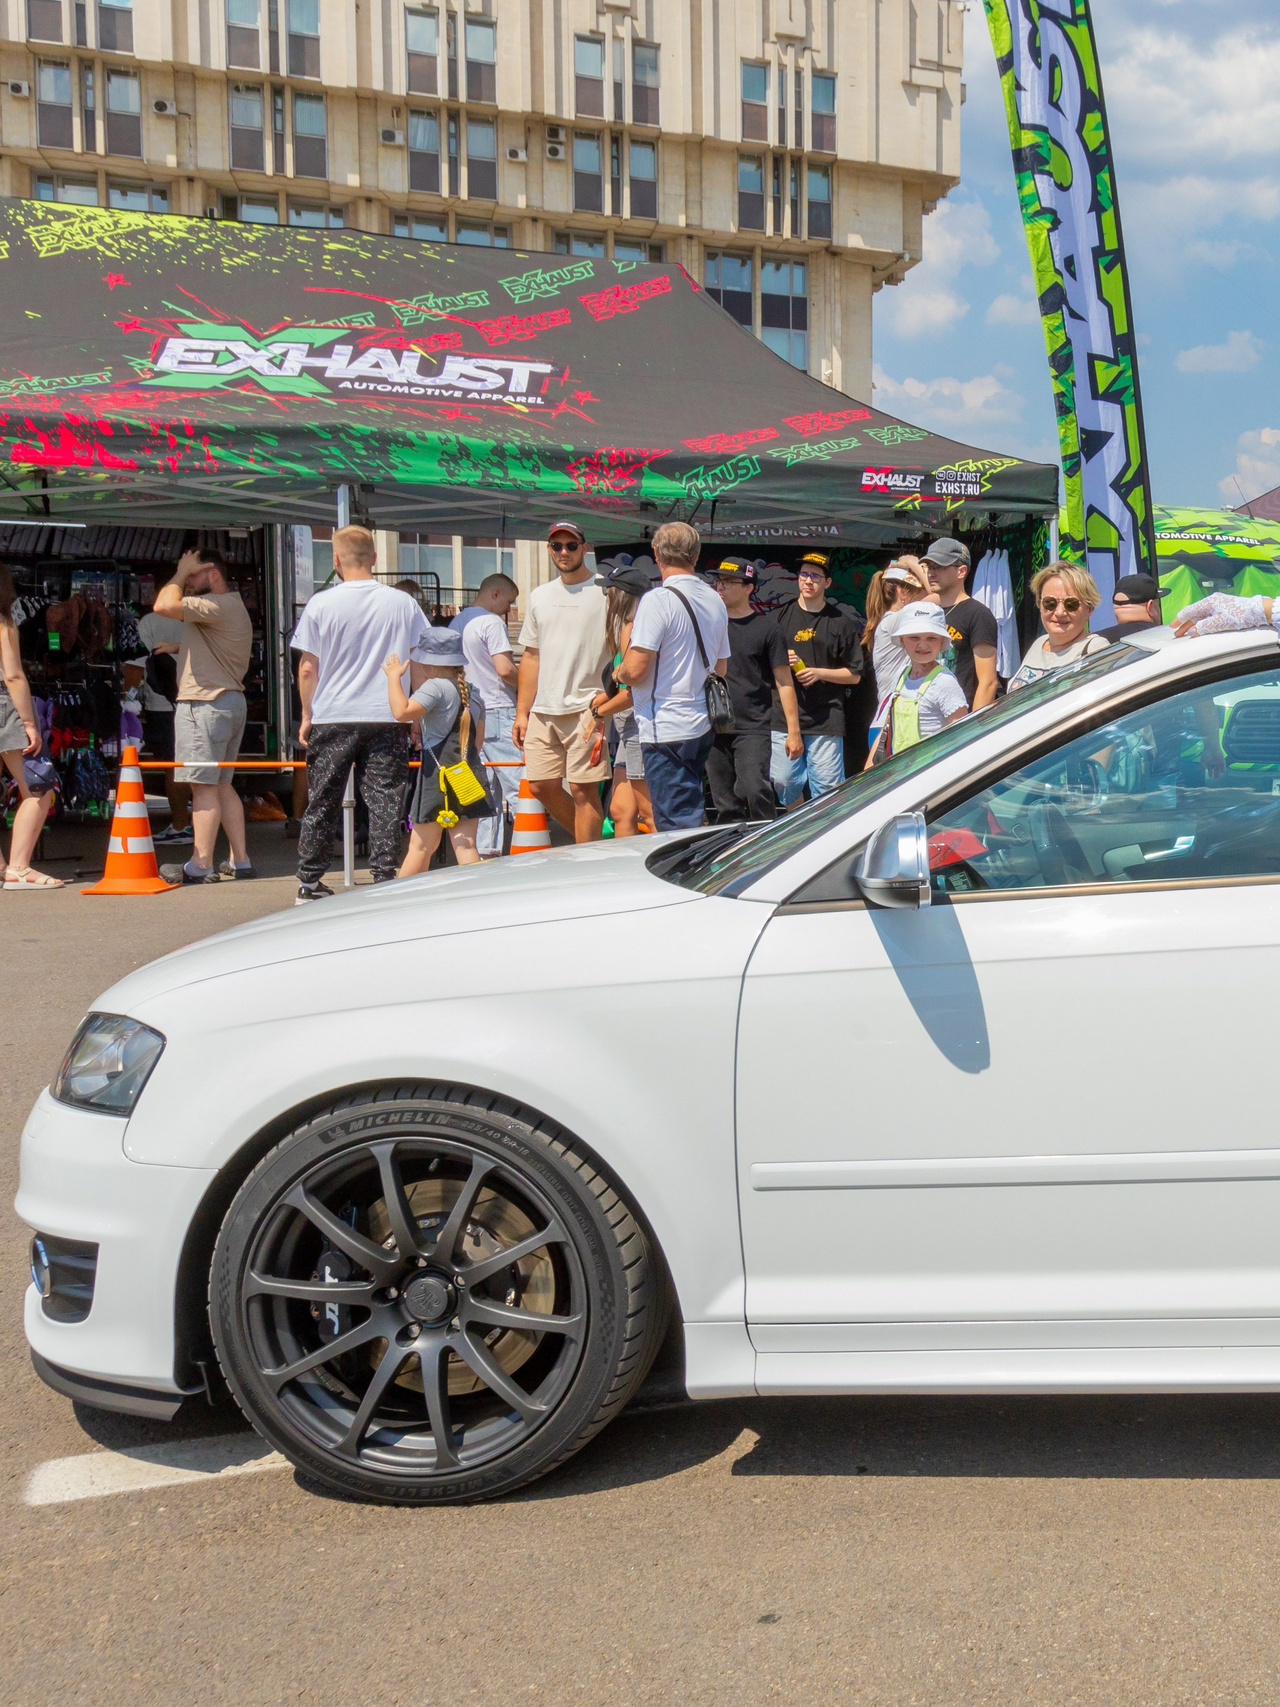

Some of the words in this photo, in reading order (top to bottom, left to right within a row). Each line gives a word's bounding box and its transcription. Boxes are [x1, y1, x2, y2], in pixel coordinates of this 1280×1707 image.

[498, 260, 594, 304] EXHAUST
[386, 290, 490, 326] EXHAUST
[578, 275, 672, 321] EXHAUST
[477, 308, 571, 346] EXHAUST
[143, 324, 552, 393] EXHAUST
[0, 372, 112, 398] XHAUST
[338, 381, 463, 399] AUTOMOTIVE
[468, 391, 545, 405] APPAREL
[860, 468, 925, 491] EXHAUST
[957, 472, 981, 482] EXHST
[1215, 535, 1260, 545] APPAREL
[350, 1111, 451, 1132] MICHELIN
[460, 1120, 501, 1140] 225/40
